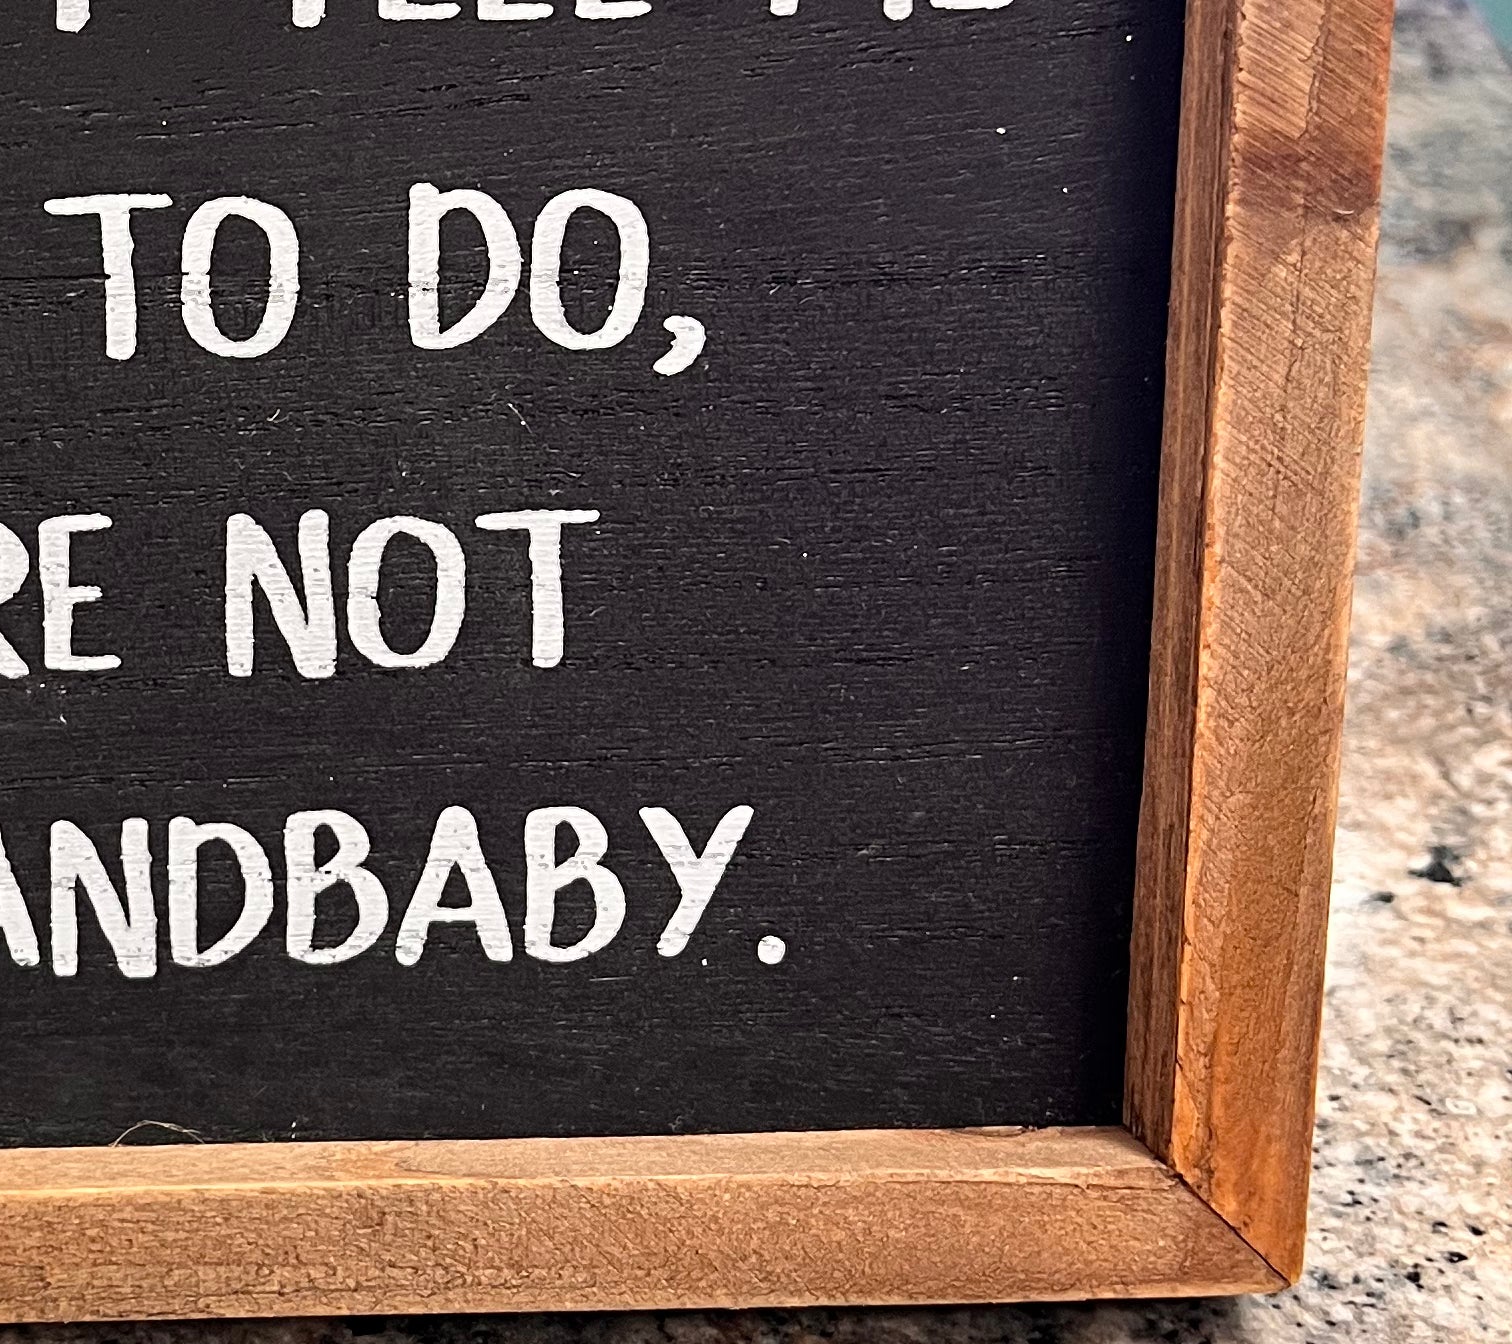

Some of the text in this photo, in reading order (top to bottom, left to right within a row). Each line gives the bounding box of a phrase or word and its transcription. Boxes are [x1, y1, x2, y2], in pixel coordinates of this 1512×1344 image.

[43, 193, 301, 361] TO
[407, 182, 707, 377] DO,
[224, 508, 601, 679] NOT
